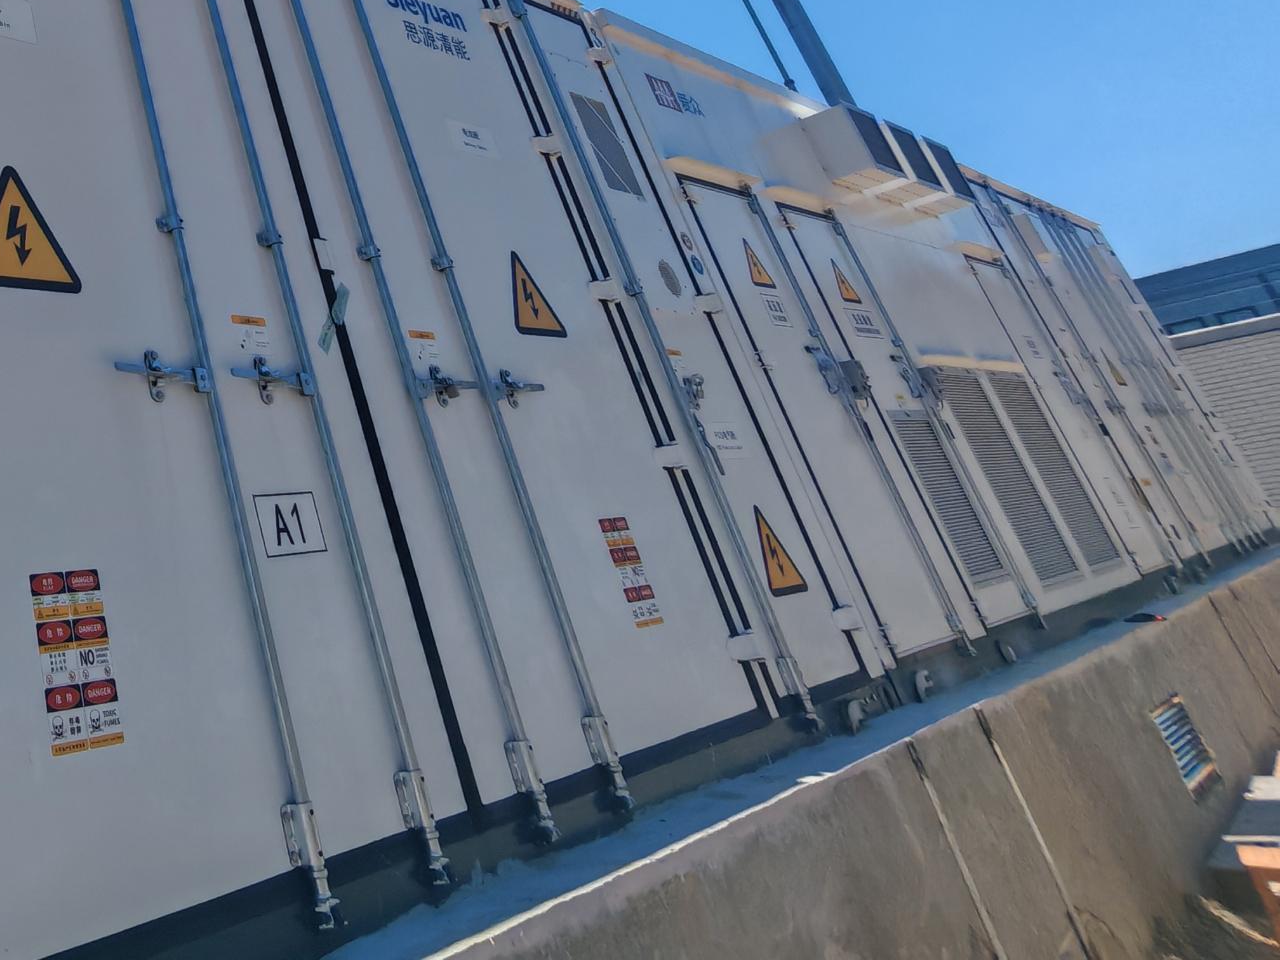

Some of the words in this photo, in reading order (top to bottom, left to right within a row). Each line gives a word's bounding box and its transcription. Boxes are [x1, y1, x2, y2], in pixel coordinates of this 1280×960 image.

[402, 19, 471, 61] 思源清能
[274, 502, 307, 547] A1
[79, 649, 95, 667] NO
